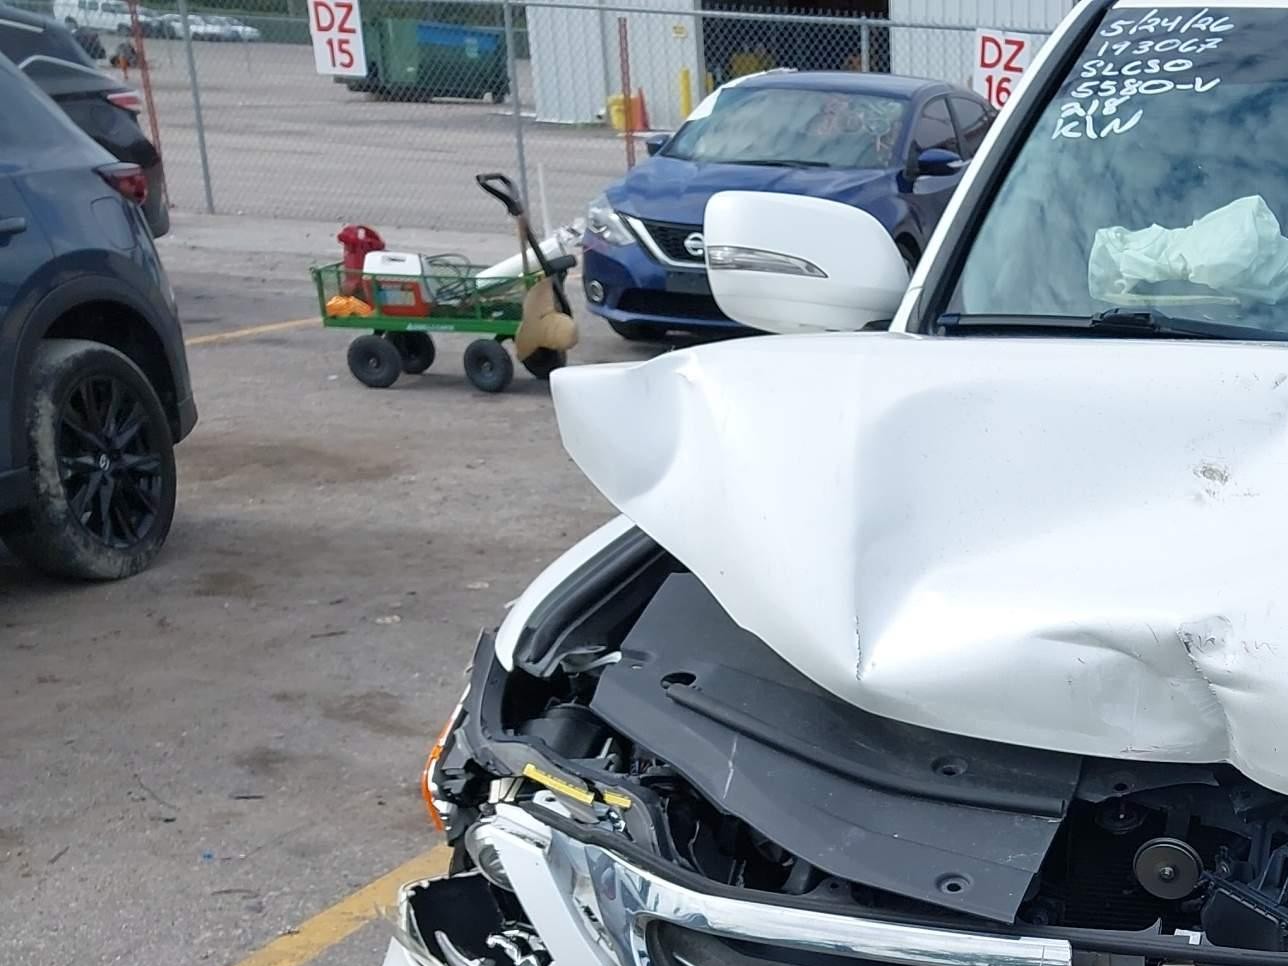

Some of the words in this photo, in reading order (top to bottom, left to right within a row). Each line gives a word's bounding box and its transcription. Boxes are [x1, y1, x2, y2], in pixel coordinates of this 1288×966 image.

[314, 1, 356, 33] DZ
[1100, 8, 1234, 36] 5/24/26
[326, 38, 354, 68] 15
[980, 36, 1024, 72] DZ
[985, 75, 1011, 107] 16
